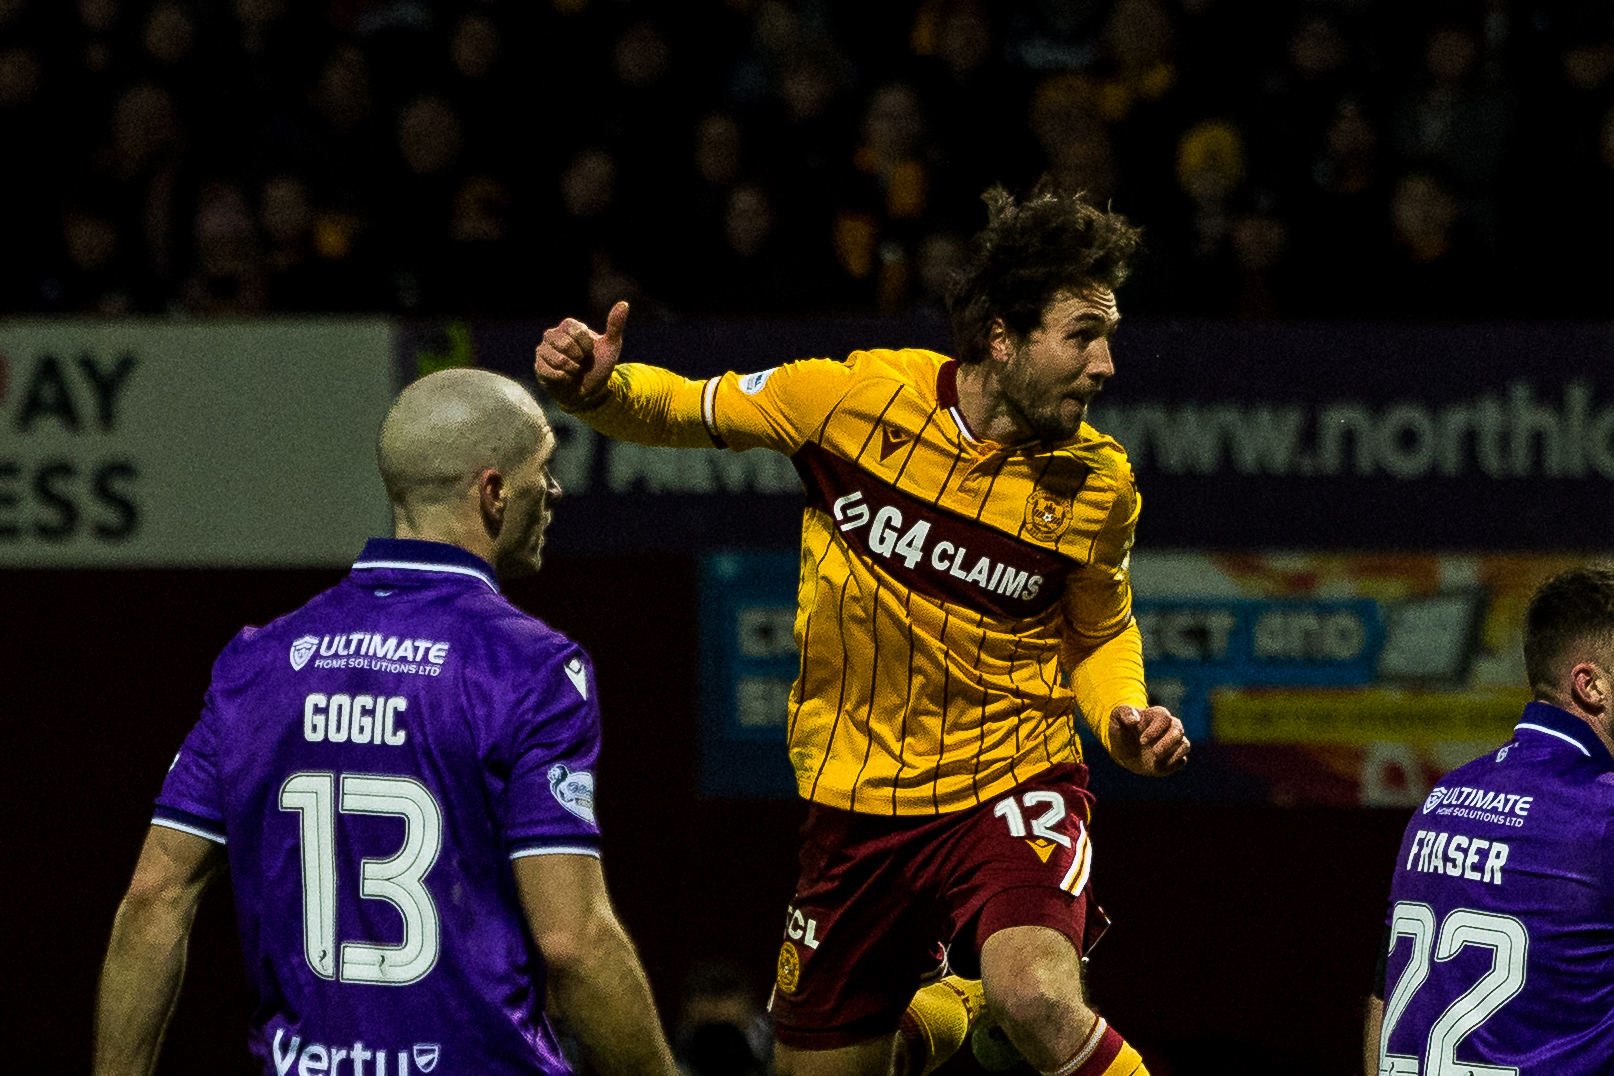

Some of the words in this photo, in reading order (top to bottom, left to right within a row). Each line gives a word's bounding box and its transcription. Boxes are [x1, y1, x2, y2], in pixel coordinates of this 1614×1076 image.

[931, 541, 1044, 600] CLAIMS
[319, 631, 449, 665] ULTIMATE
[348, 658, 417, 675] SOLUTIONS
[418, 664, 442, 677] LTD
[304, 692, 409, 746] GOGIC
[993, 790, 1072, 849] 12
[1443, 786, 1534, 816] ULTIMATE
[1453, 807, 1505, 826] SOLUTIONS
[1505, 816, 1524, 828] LTD
[278, 771, 442, 986] 13
[1406, 829, 1510, 885] FRASER
